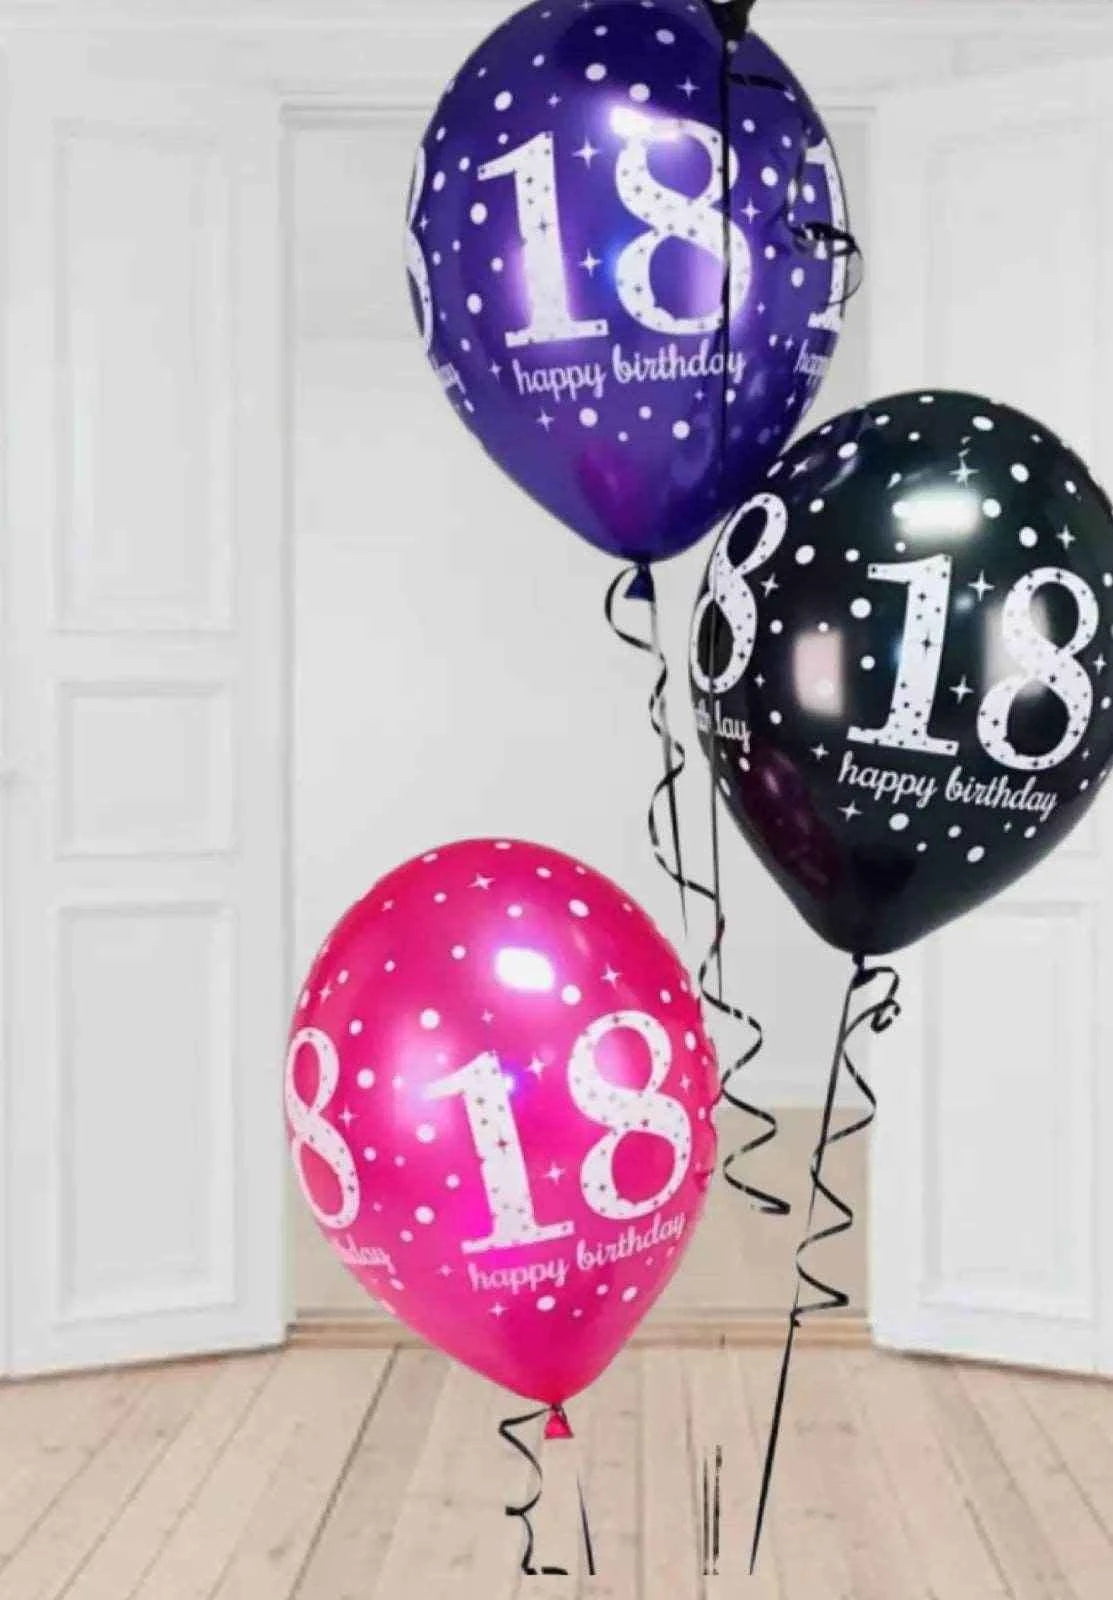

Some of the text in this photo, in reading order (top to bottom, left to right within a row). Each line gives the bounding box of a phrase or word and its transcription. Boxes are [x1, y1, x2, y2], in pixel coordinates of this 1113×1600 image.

[477, 113, 752, 348] 18
[512, 358, 607, 402] happy
[612, 338, 747, 385] birthday
[846, 553, 1100, 772] 18
[838, 750, 1058, 823] happy birthday
[422, 1010, 692, 1254] 18
[467, 1211, 686, 1296] happy birthday
